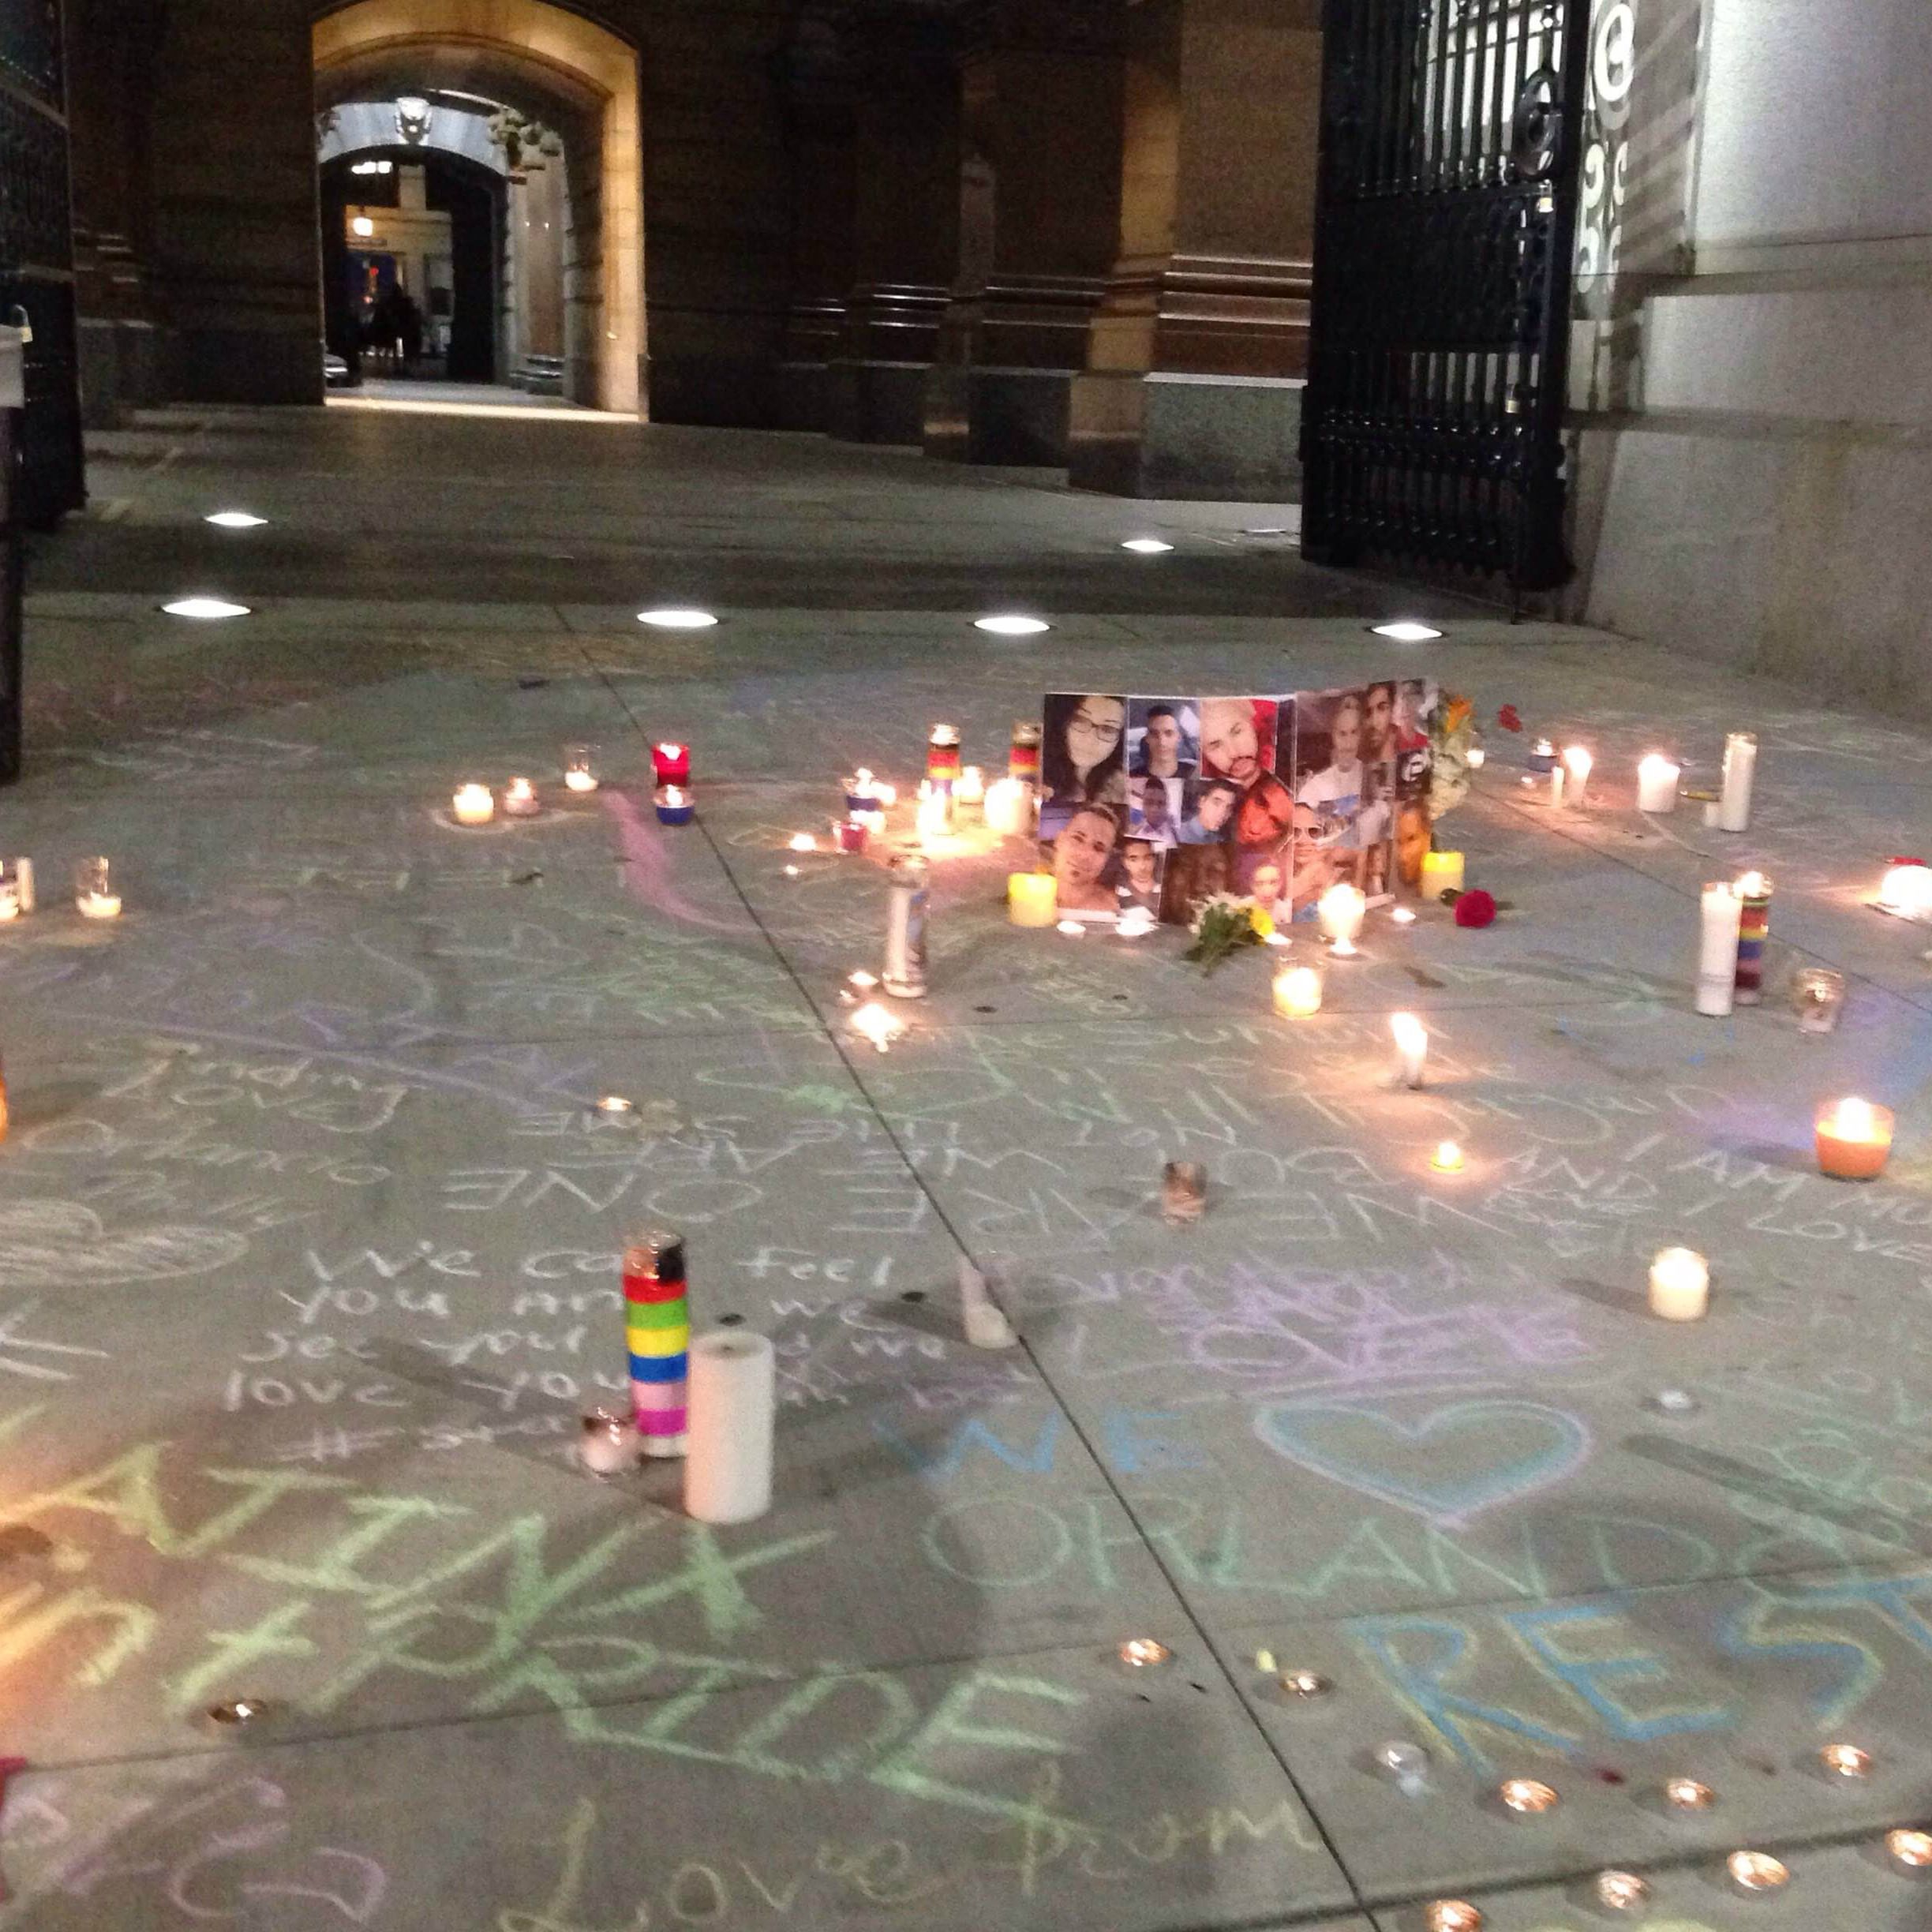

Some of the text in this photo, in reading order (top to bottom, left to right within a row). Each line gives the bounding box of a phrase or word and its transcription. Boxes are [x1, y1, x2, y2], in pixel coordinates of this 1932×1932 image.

[819, 1144, 1067, 1177] WE
[1664, 1150, 1812, 1202] AM
[442, 1170, 764, 1224] ONE
[826, 1186, 1156, 1249] ARE
[1236, 1190, 1518, 1241] WE
[1745, 1214, 1932, 1264] LOVE
[520, 1247, 623, 1279] ca
[732, 1245, 896, 1288] feel
[275, 1286, 453, 1325] you
[224, 1369, 410, 1413] love
[874, 1408, 1204, 1482] WE
[920, 1492, 1853, 1607] ORLANDO
